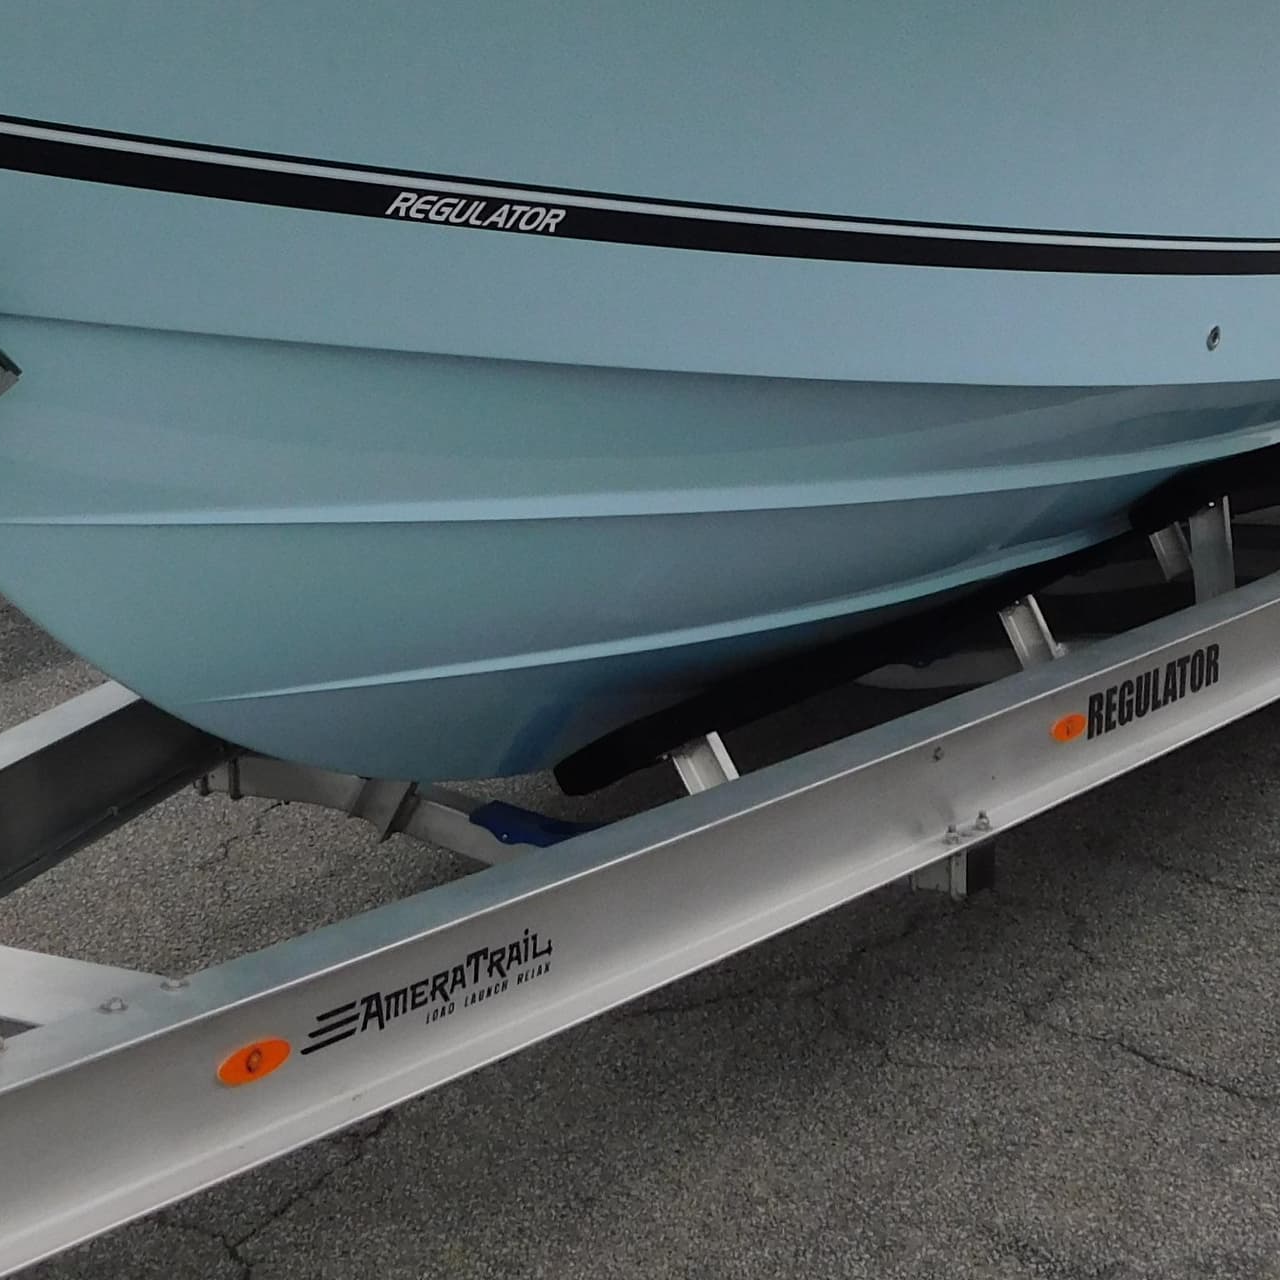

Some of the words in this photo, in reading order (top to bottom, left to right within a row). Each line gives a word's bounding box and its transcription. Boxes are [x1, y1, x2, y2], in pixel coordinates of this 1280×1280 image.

[385, 191, 566, 232] REGULATOR
[1087, 643, 1220, 740] REGULATOR
[464, 979, 509, 1008] LAUNCH
